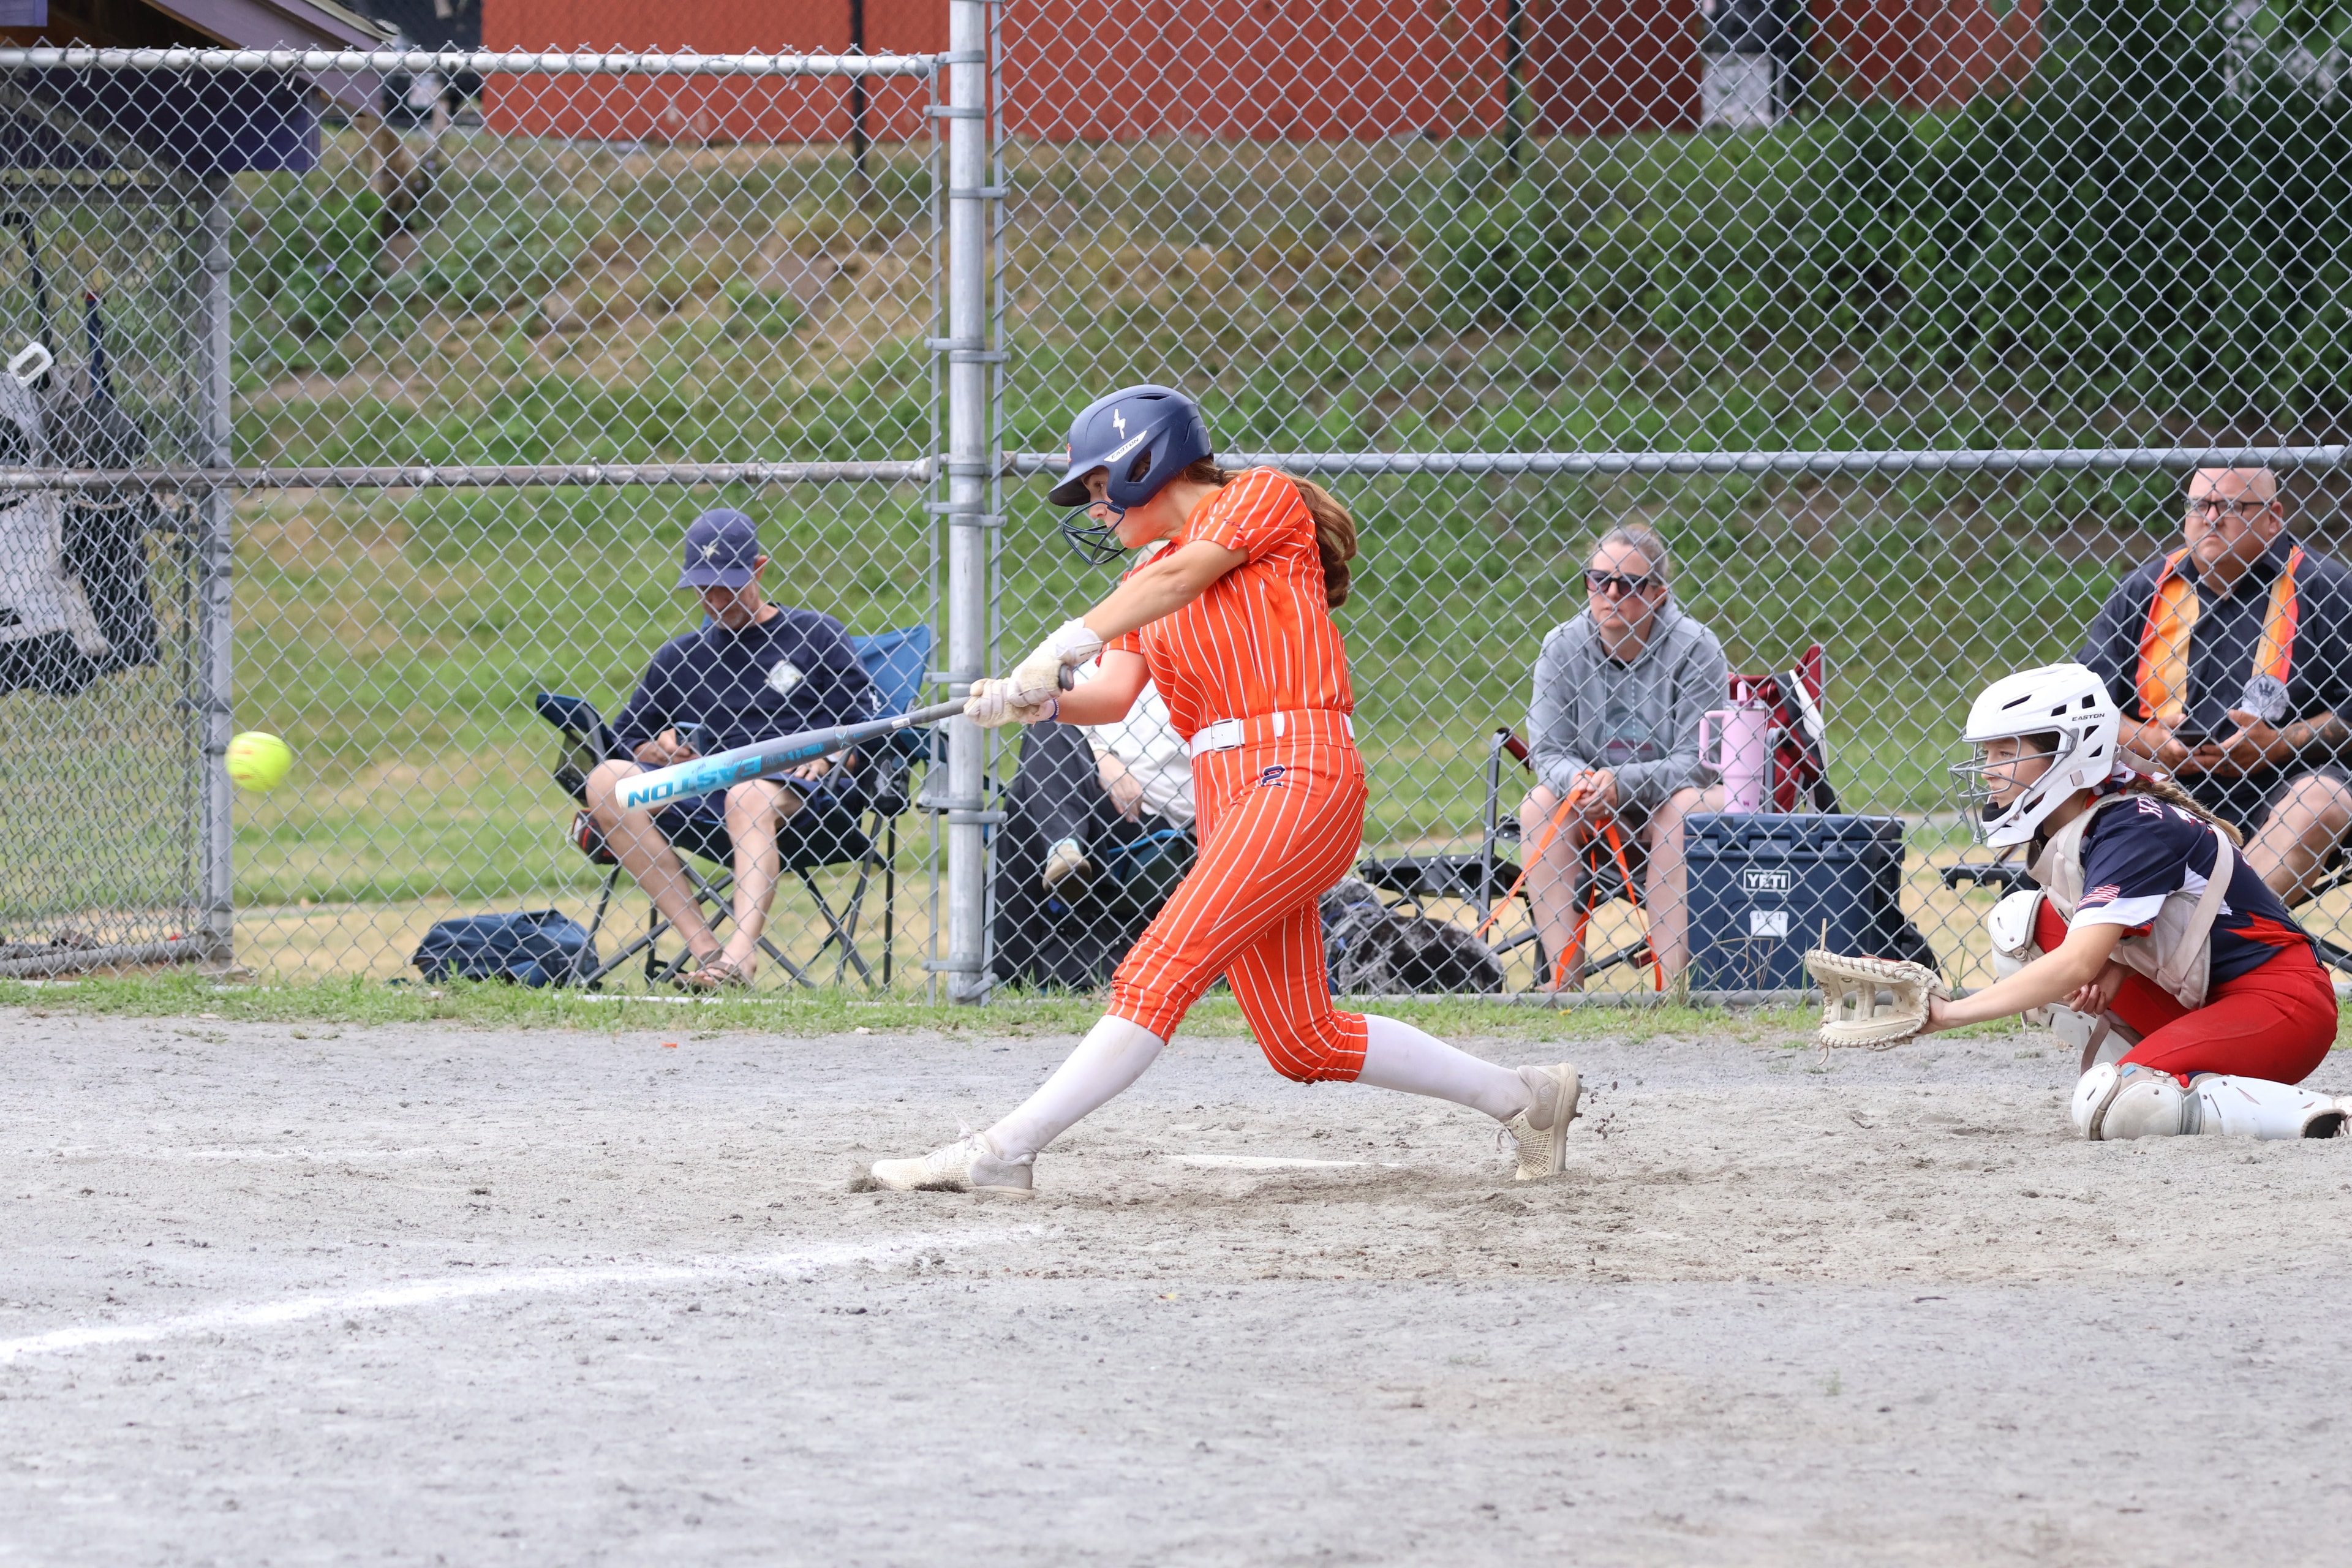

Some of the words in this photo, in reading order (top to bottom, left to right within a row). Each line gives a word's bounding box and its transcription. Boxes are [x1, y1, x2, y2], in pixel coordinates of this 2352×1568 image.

[1111, 438, 1139, 459] EASTON
[2071, 713, 2105, 722] EASTON
[627, 755, 762, 808] EASTON
[1747, 873, 1787, 888] YETI
